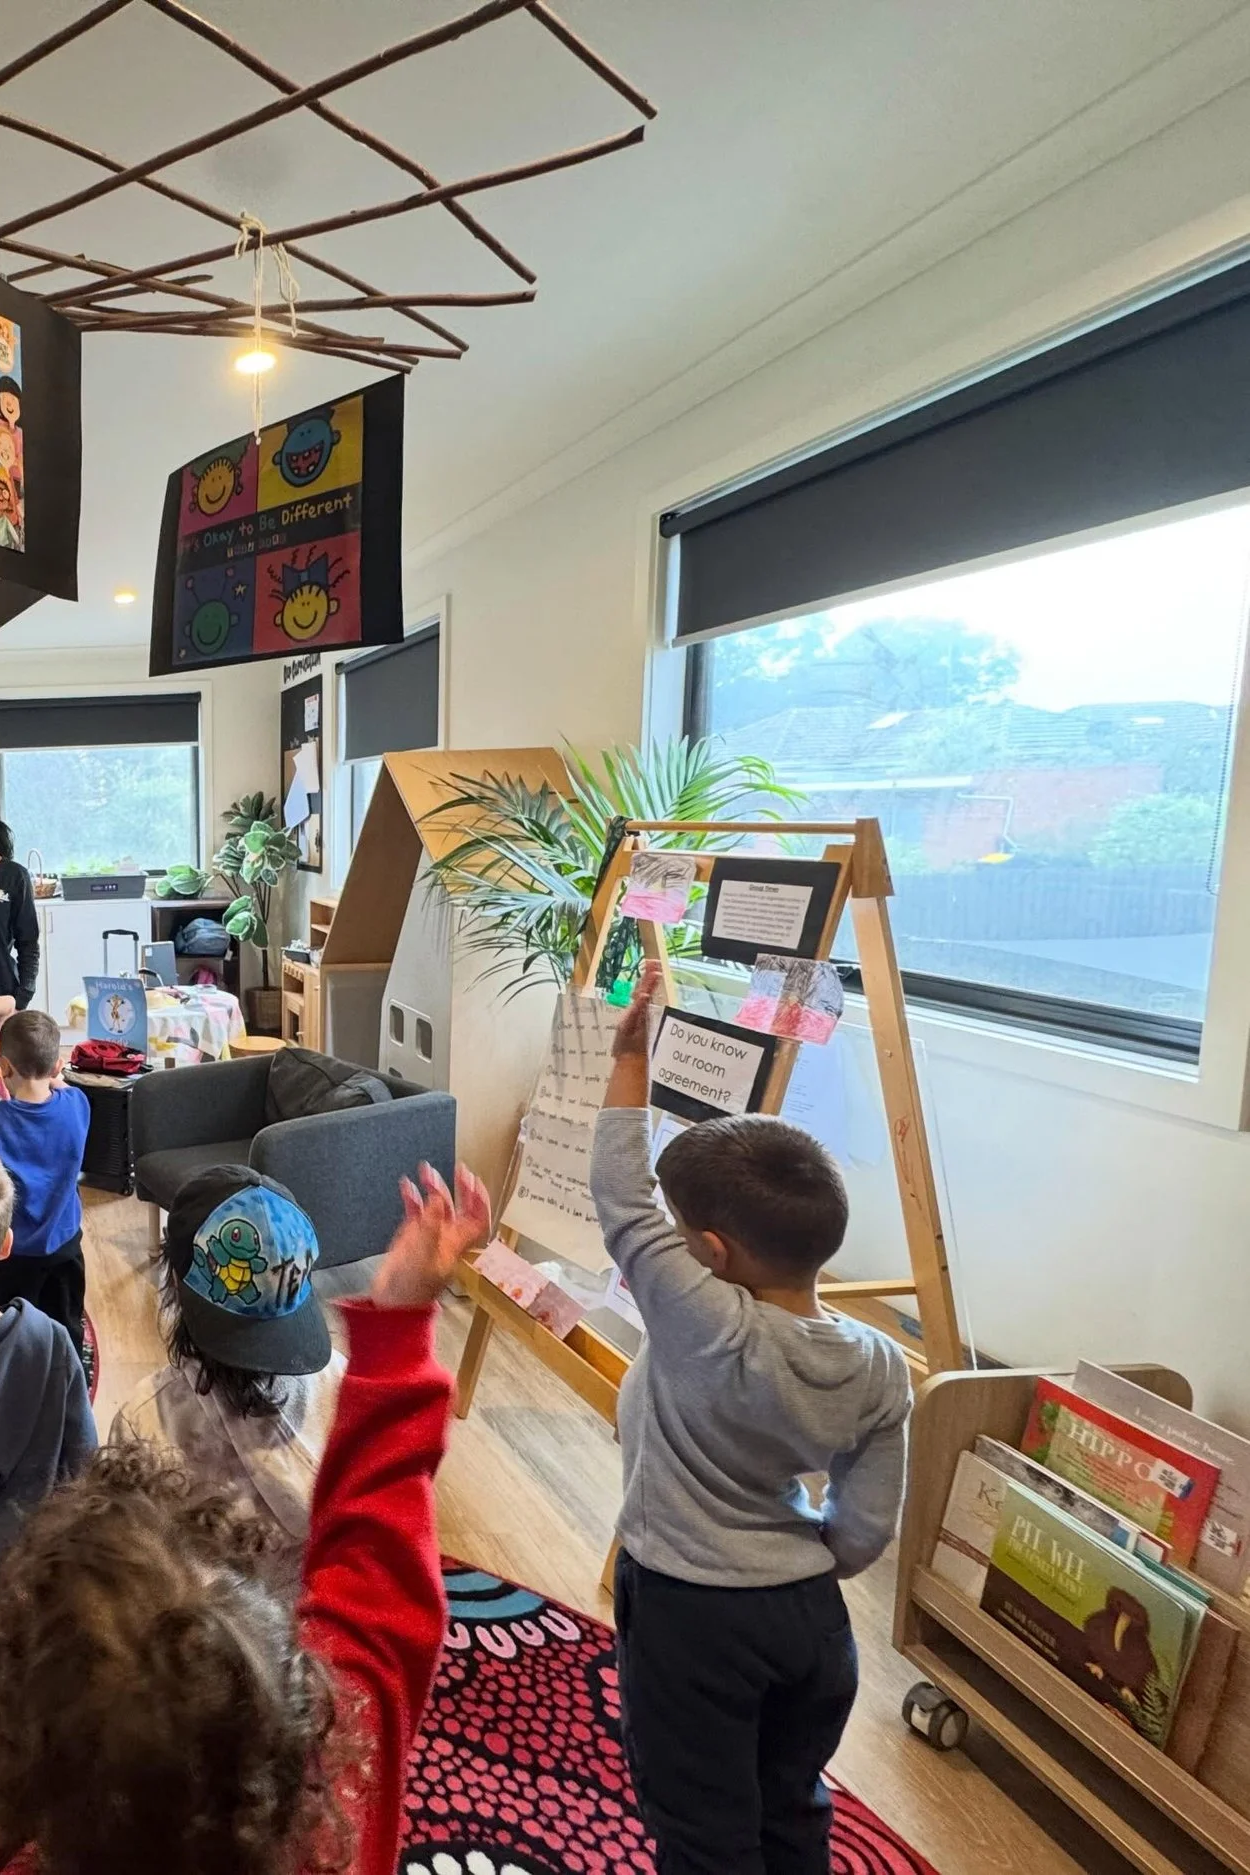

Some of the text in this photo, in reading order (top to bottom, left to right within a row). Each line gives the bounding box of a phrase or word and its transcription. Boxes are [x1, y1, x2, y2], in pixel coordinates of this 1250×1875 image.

[203, 529, 235, 547] Okay
[239, 522, 254, 537] to
[259, 514, 276, 531] Be
[281, 492, 353, 526] Different
[670, 1023, 748, 1060] Do you know
[672, 1050, 726, 1079] our room
[658, 1067, 731, 1104] agreement?
